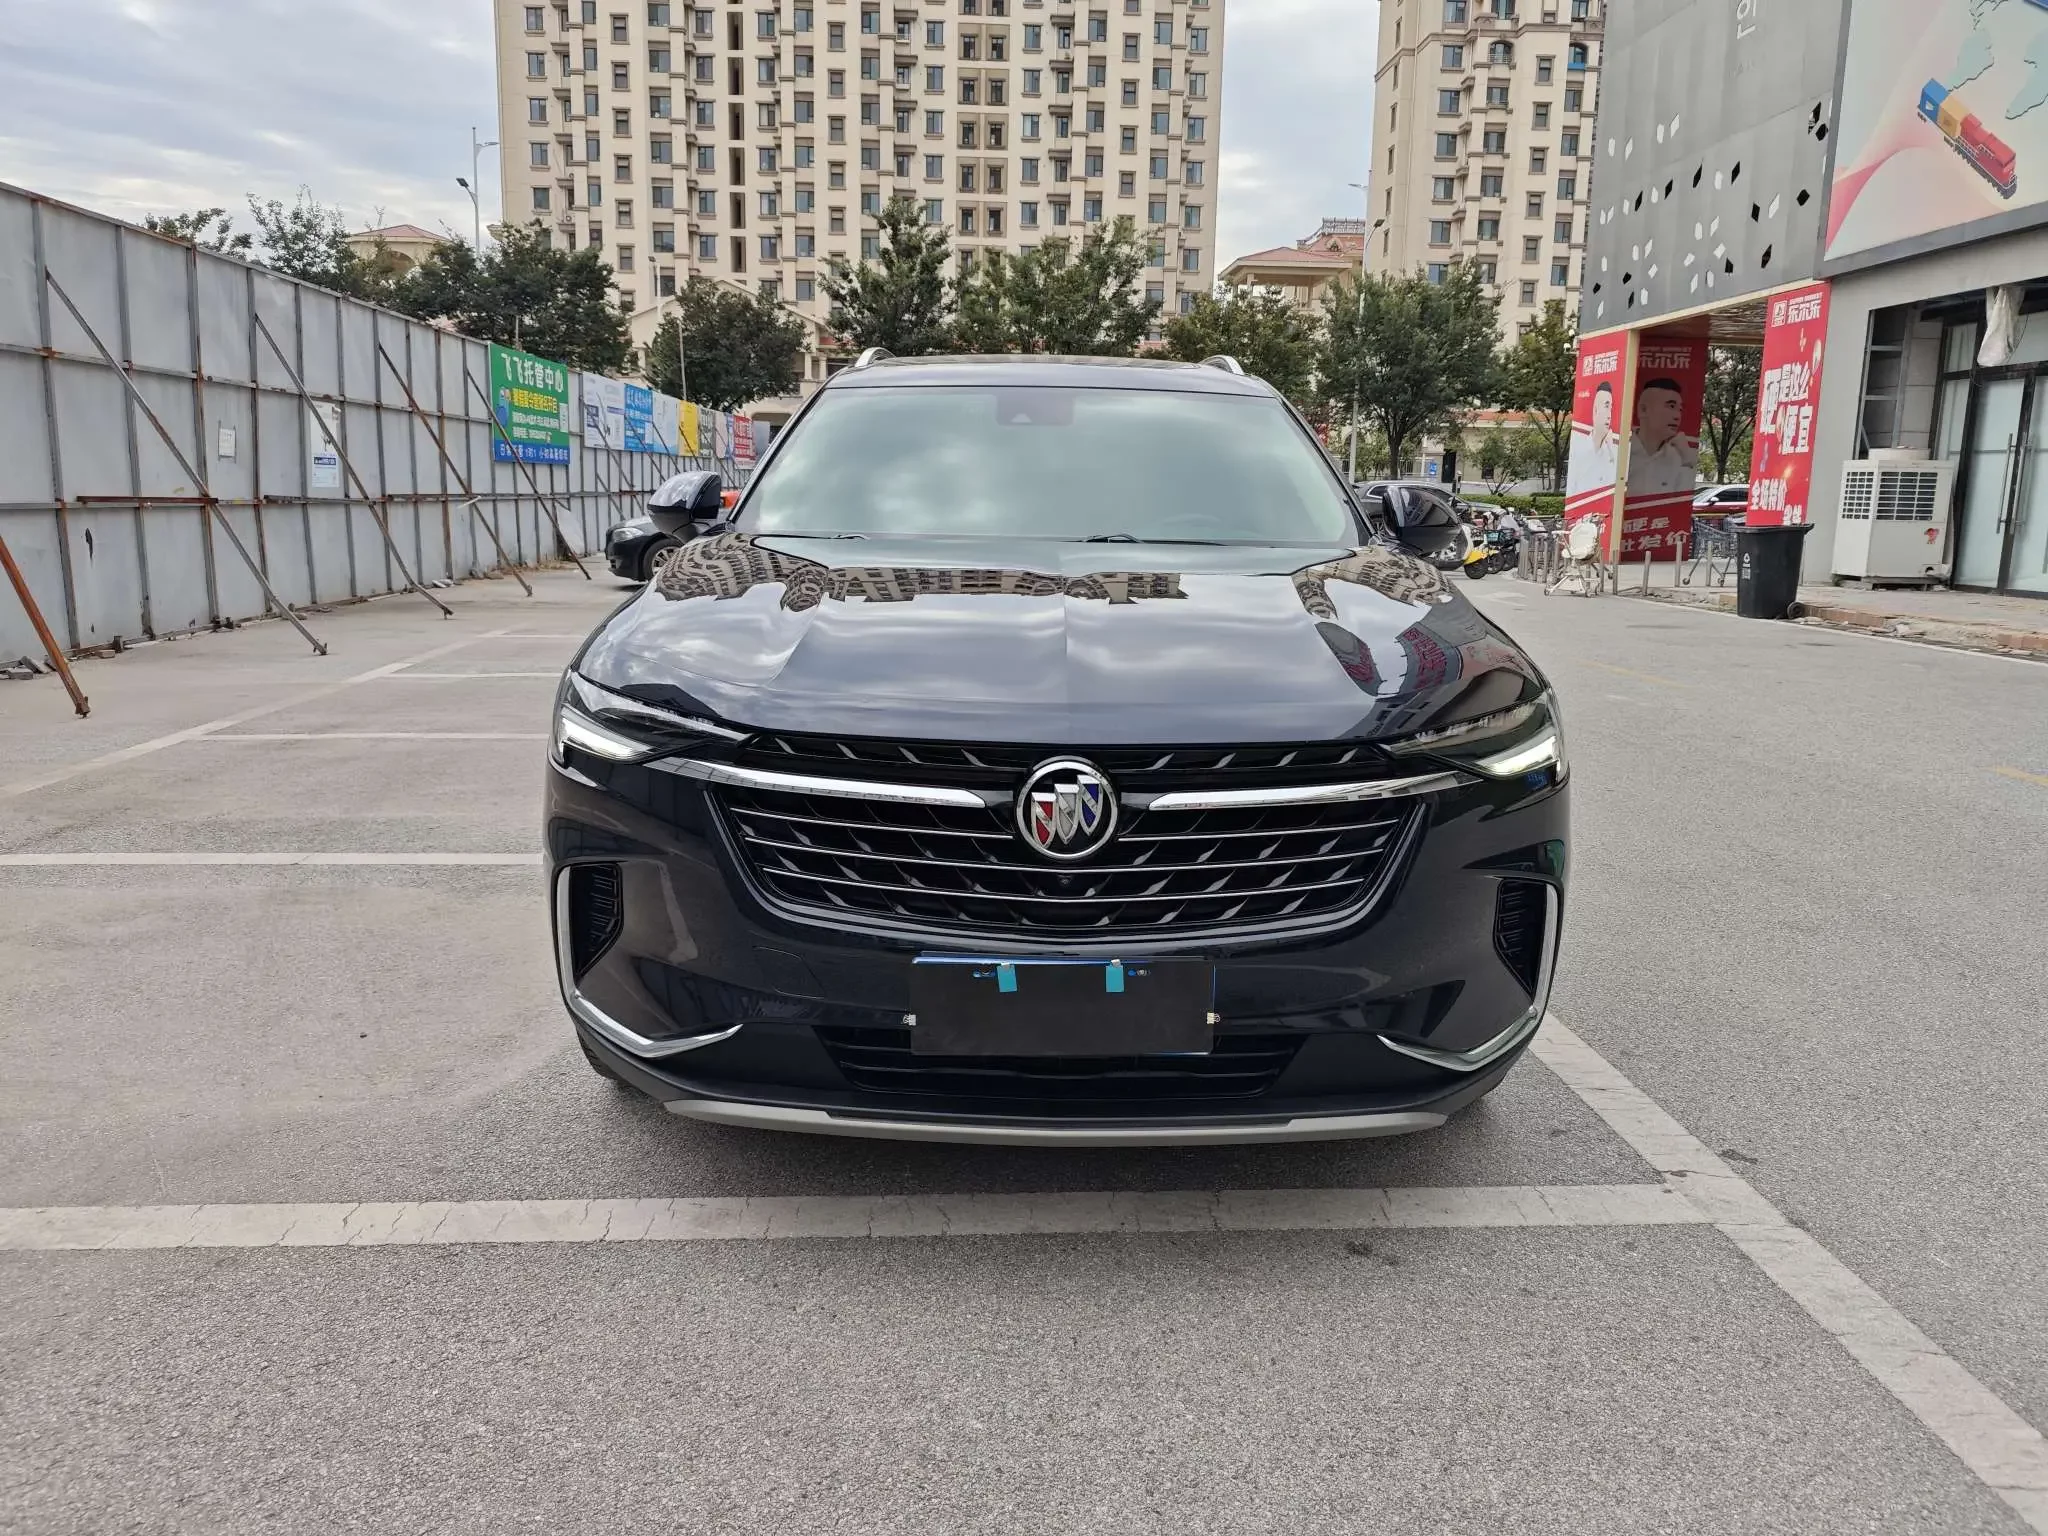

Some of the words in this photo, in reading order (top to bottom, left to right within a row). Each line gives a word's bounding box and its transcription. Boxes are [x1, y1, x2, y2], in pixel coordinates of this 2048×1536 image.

[501, 353, 564, 393] 飞飞托管中心
